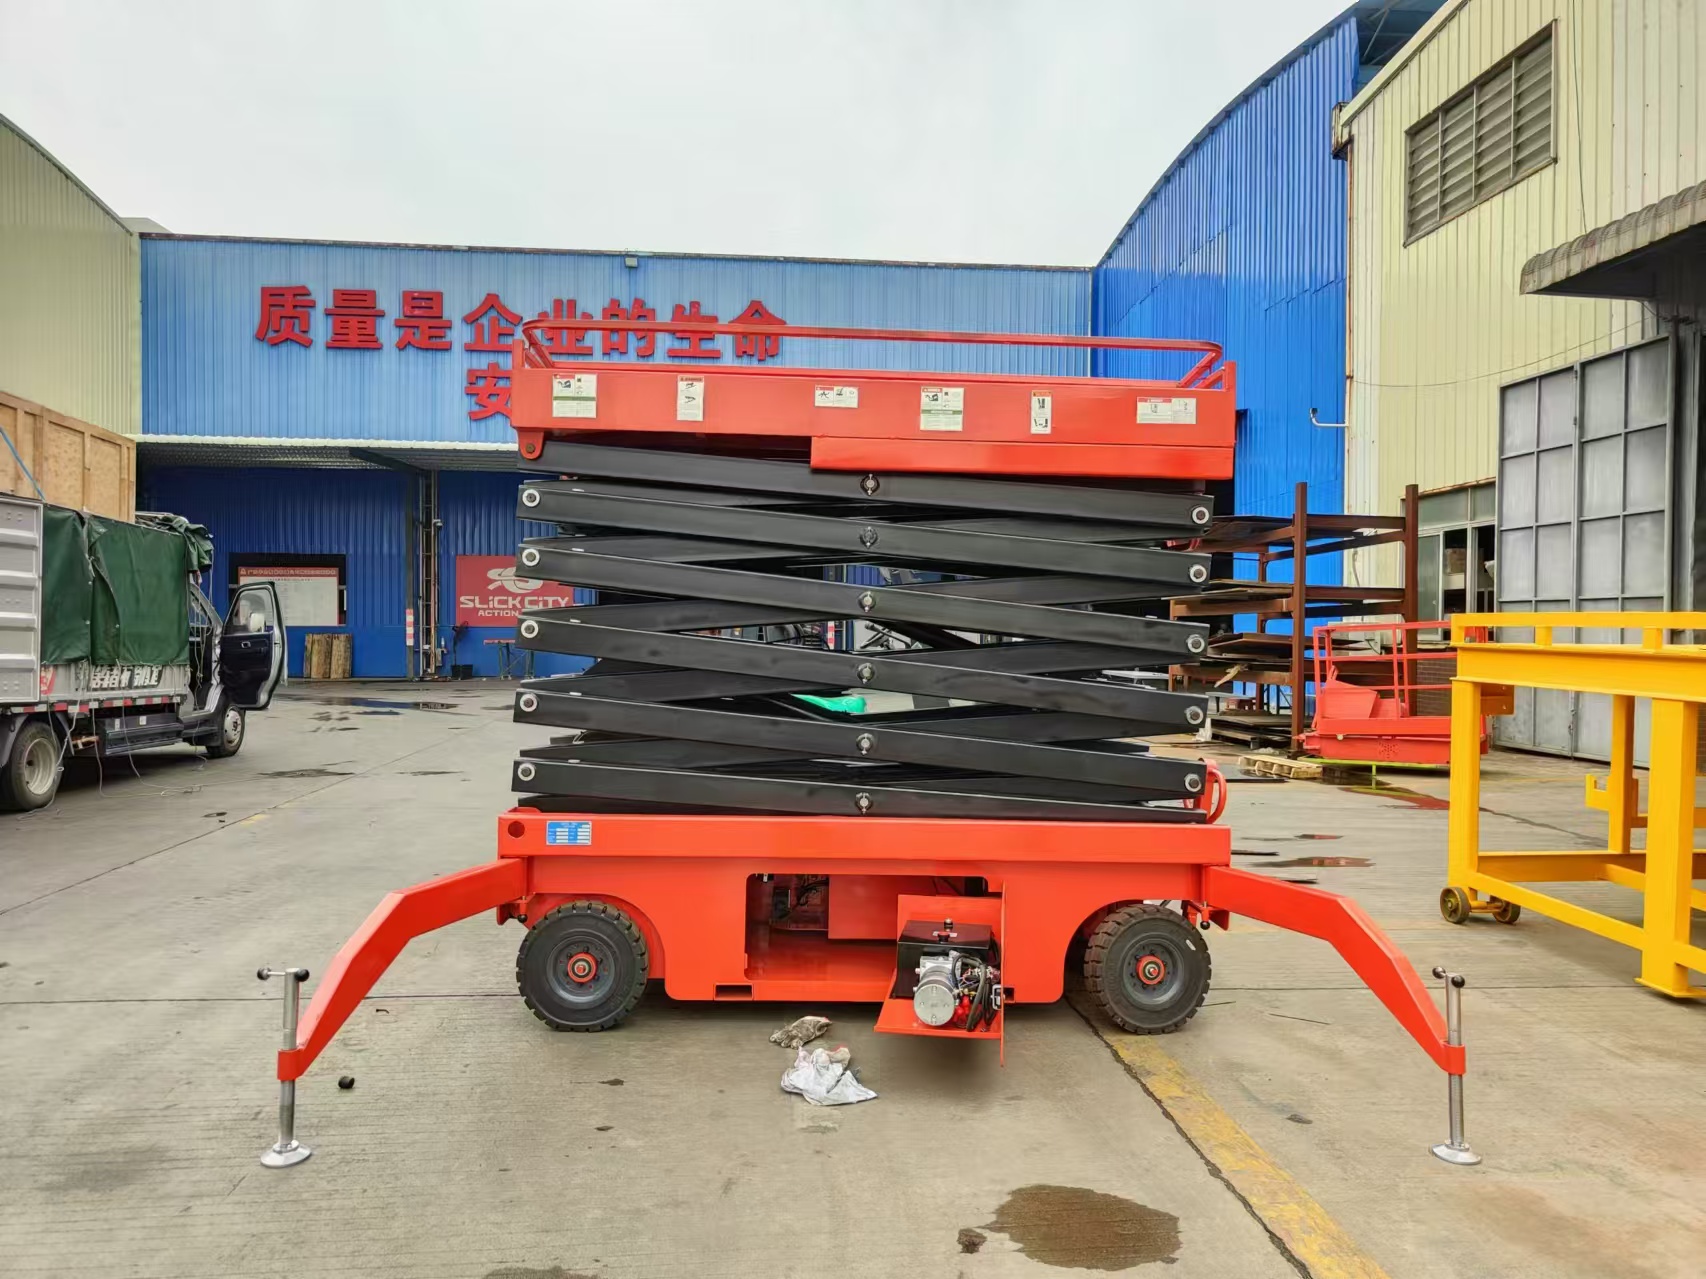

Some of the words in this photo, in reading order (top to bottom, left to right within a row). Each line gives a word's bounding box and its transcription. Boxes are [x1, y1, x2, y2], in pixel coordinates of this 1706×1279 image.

[255, 285, 786, 361] 质量是企业的生命
